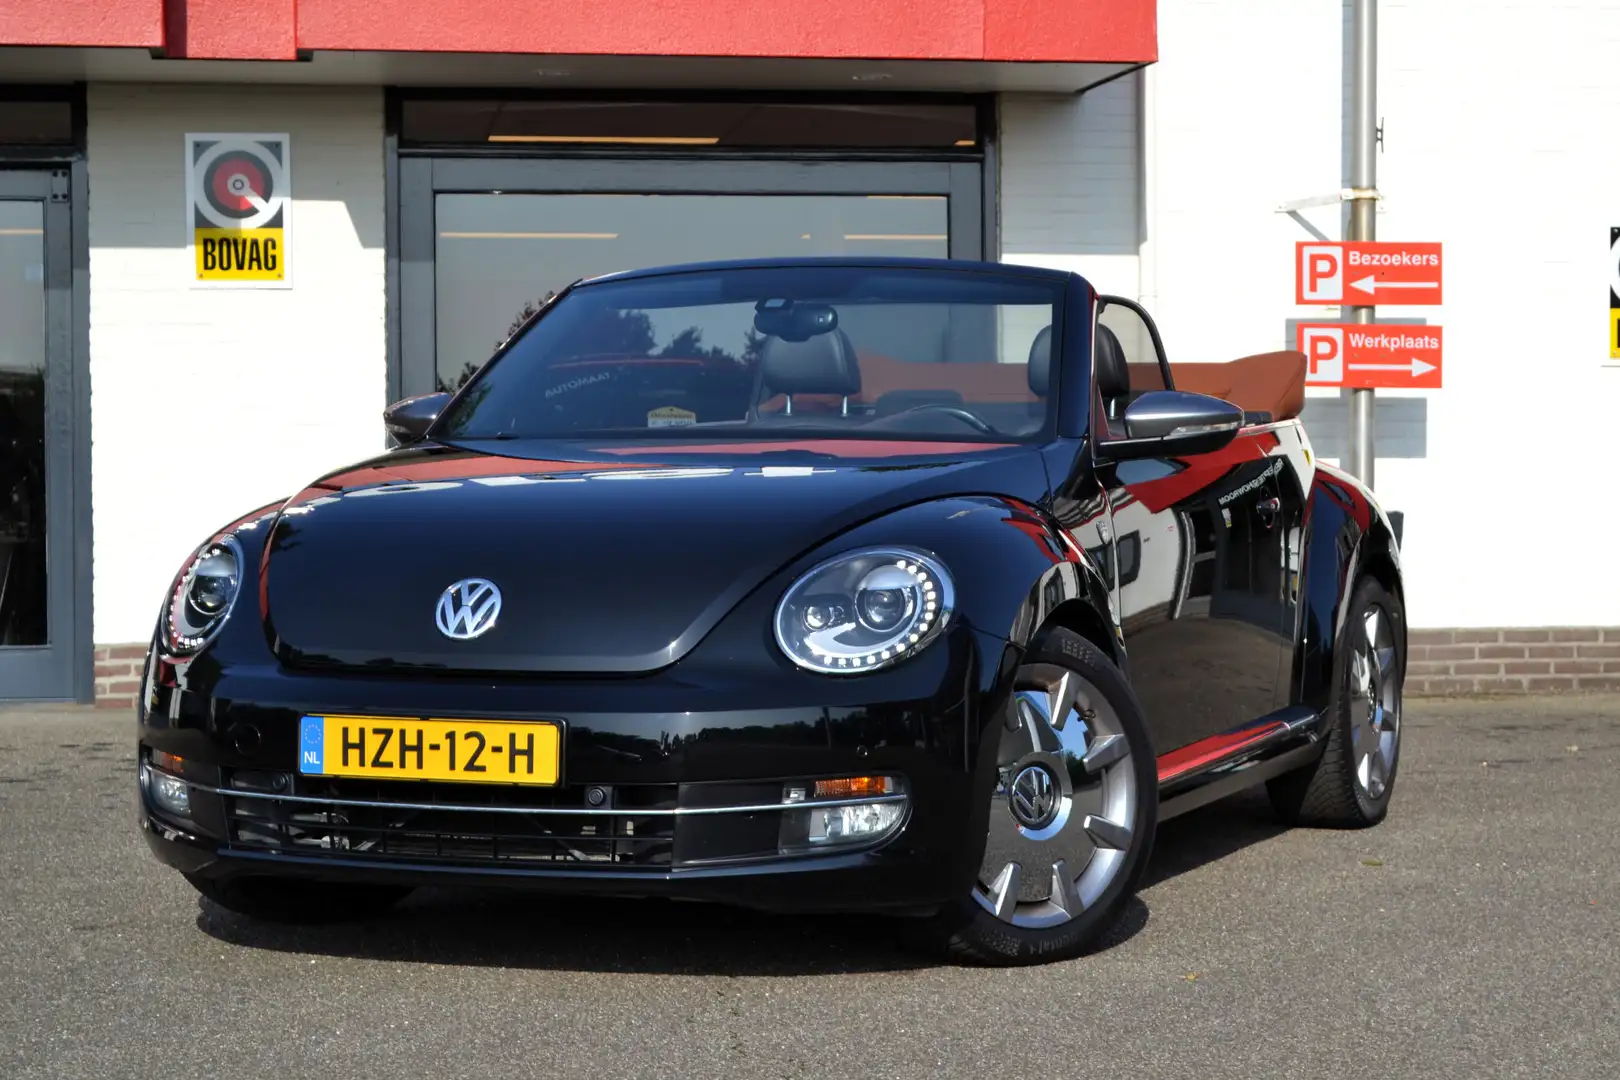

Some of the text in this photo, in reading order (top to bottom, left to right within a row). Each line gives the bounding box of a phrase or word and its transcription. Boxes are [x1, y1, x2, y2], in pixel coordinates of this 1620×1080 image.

[203, 238, 276, 270] BOVAG
[1309, 251, 1438, 292] P Bezoekers
[1310, 334, 1439, 374] P Werkplaats
[304, 727, 534, 774] NL HZH-12-H
